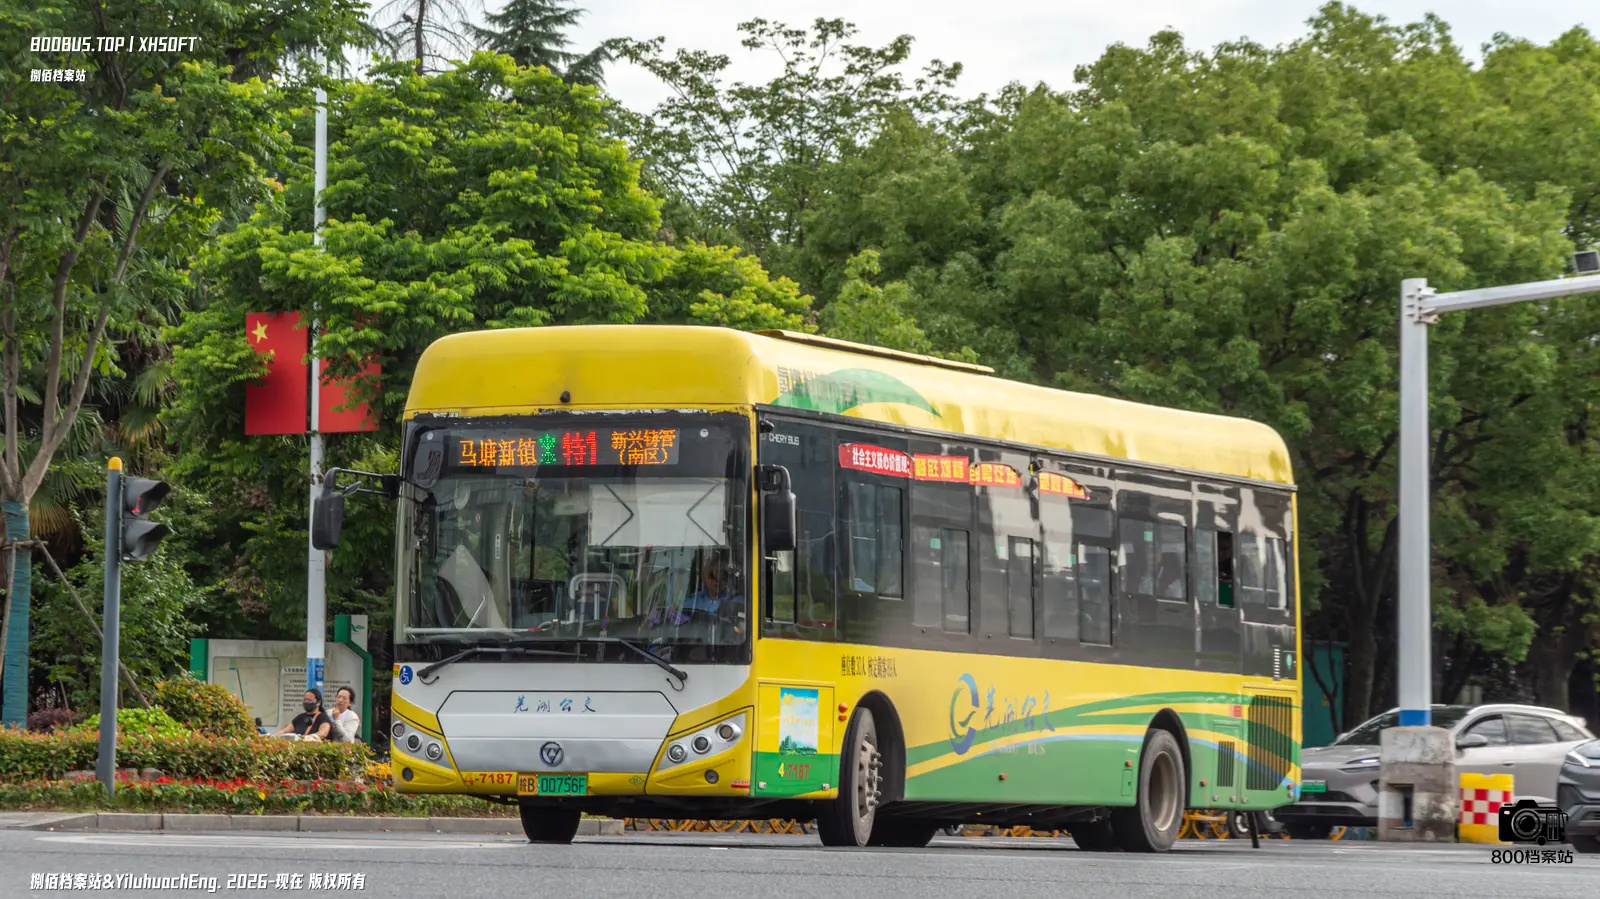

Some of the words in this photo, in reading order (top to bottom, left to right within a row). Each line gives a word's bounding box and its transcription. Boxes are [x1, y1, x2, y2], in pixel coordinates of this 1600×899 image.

[611, 429, 676, 449] 新兴铸管
[768, 432, 788, 444] CHERY
[788, 435, 800, 446] BUS
[465, 773, 513, 785] 4-7187
[778, 762, 810, 780] 4-7187
[541, 777, 587, 793] 00756F
